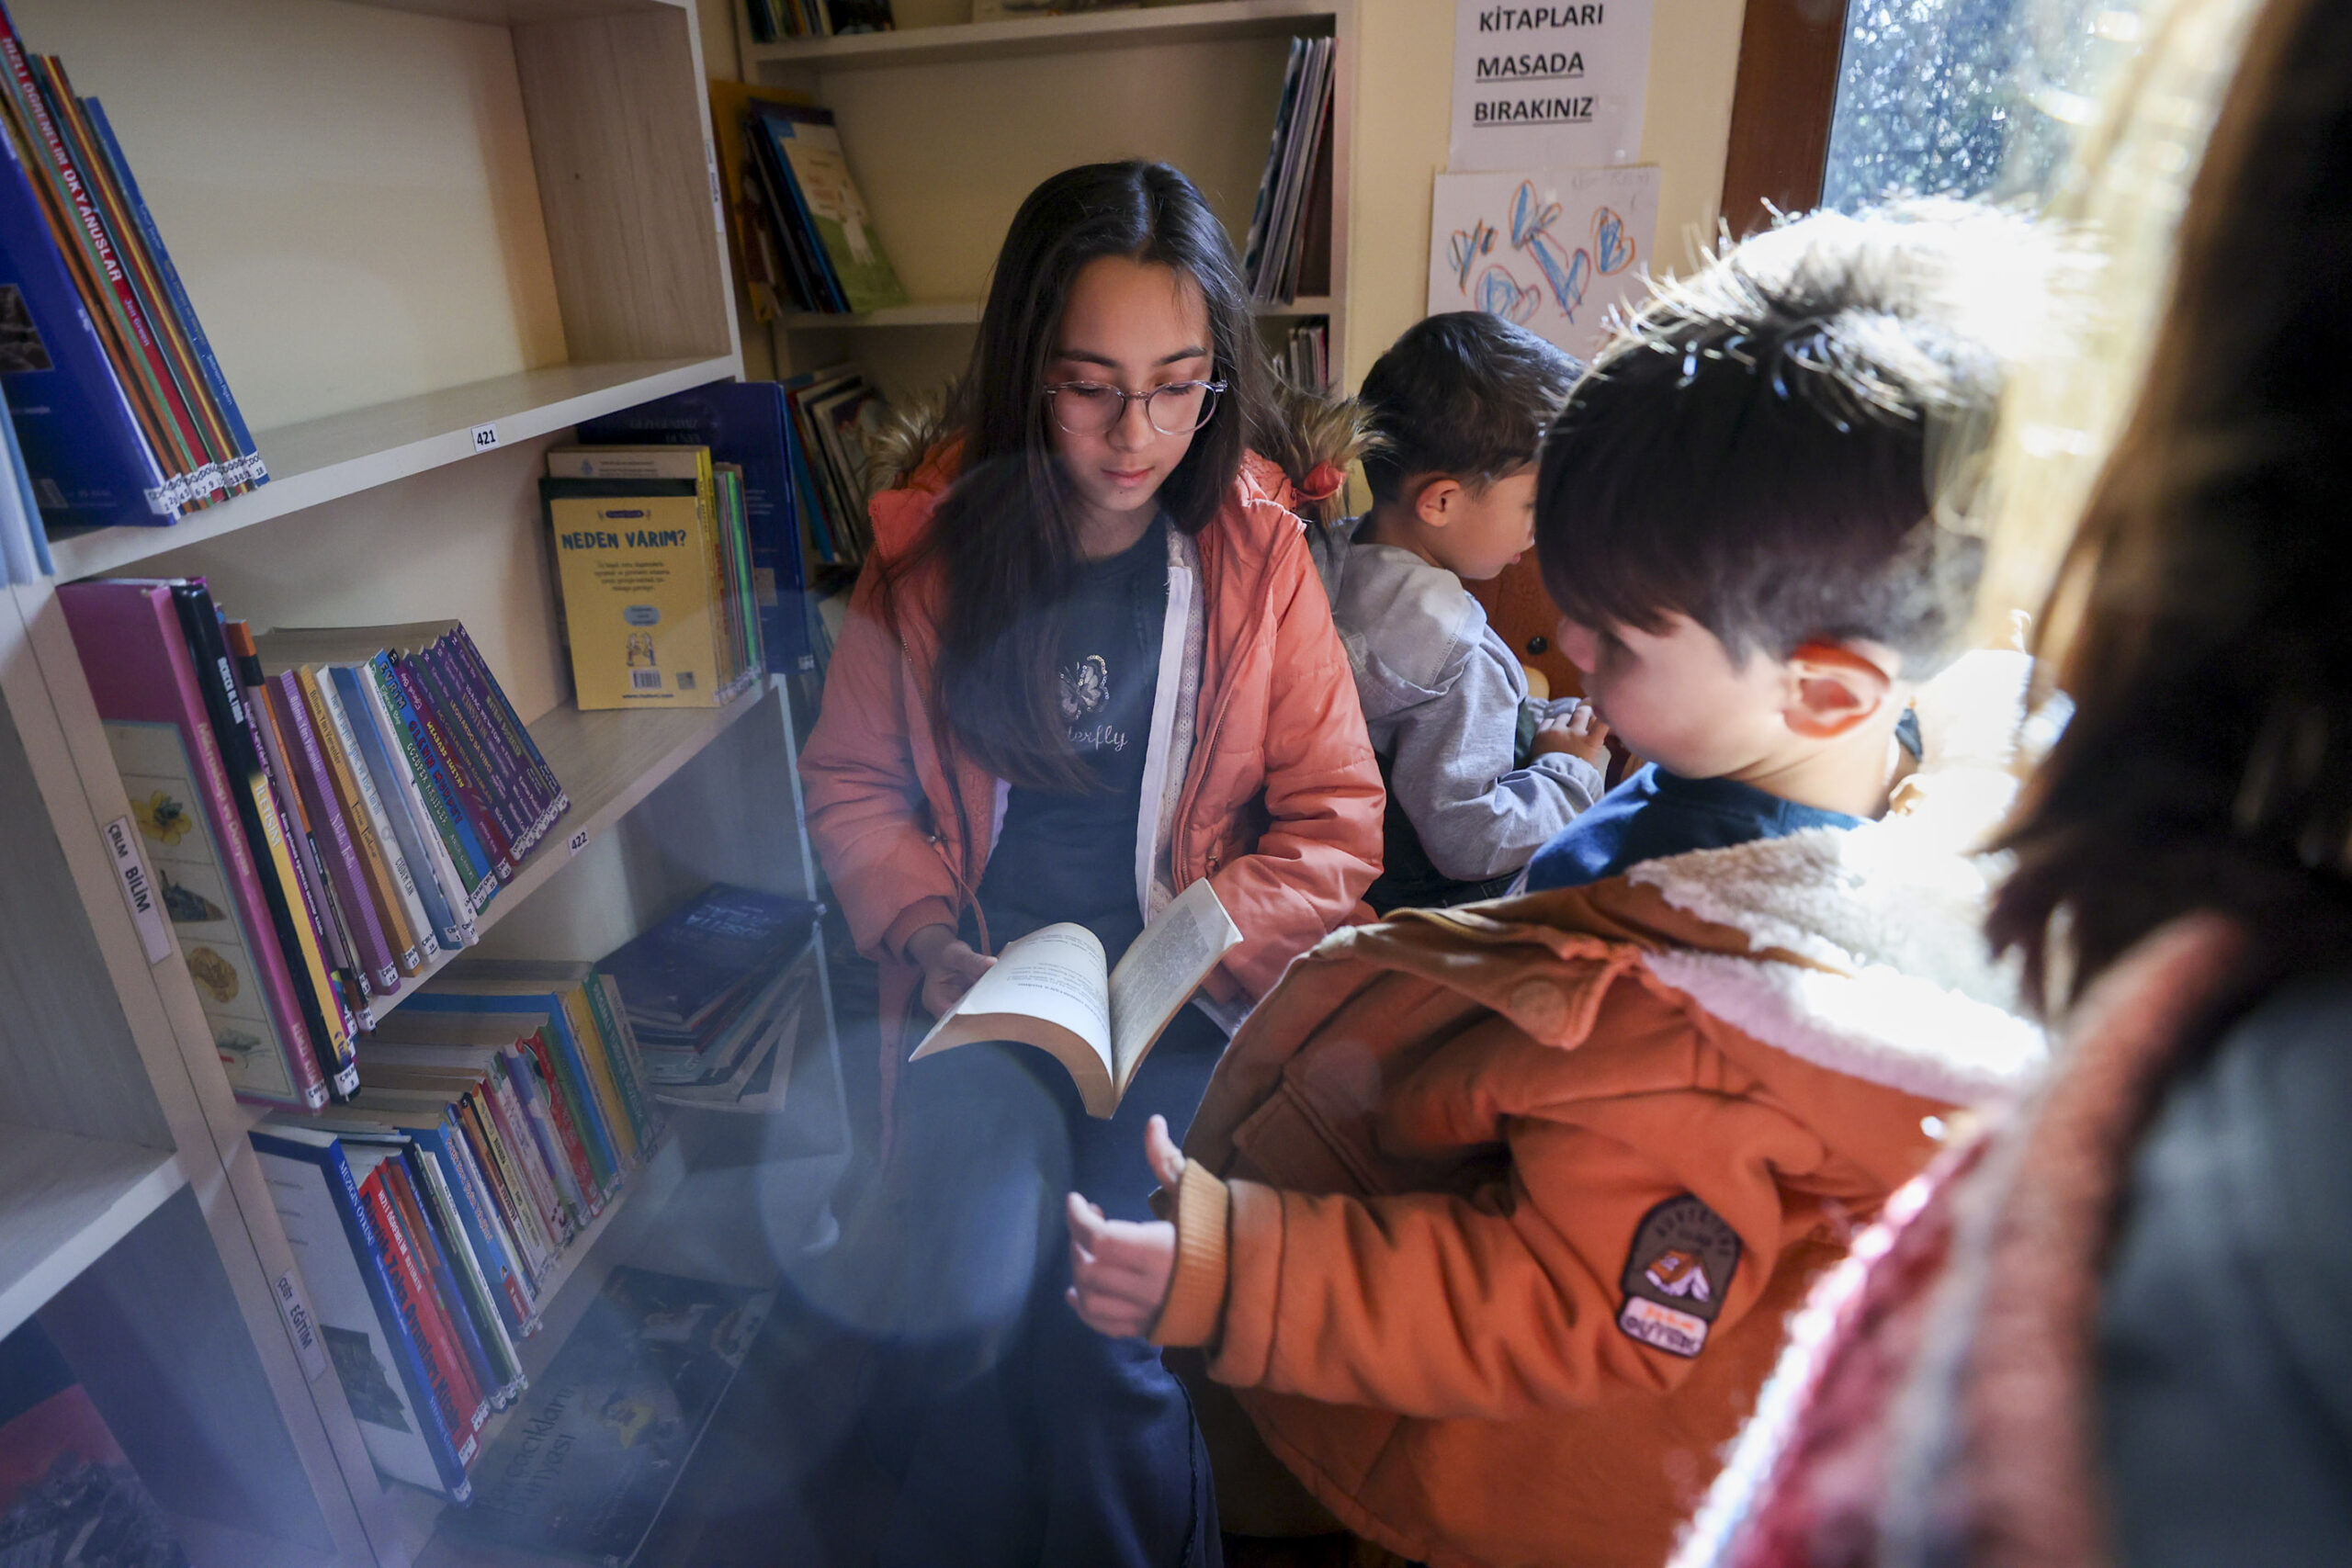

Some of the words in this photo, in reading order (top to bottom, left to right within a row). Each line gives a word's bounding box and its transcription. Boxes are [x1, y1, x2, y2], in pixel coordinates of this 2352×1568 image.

[1479, 4, 1604, 32] KİTAPLARI
[1476, 51, 1585, 79] MASADA
[1474, 96, 1594, 123] BIRAKINIZ
[63, 169, 122, 282] OKYANUSLAR
[477, 428, 496, 446] 421
[561, 531, 619, 550] NEDEN
[626, 529, 686, 548] VARIM?
[379, 662, 407, 709] EVRİM
[409, 720, 435, 769] GLENN
[571, 831, 588, 850] 422
[107, 824, 129, 859] ÇBLM
[125, 865, 152, 914] BİLİM
[290, 1303, 312, 1350] EĞİTİM
